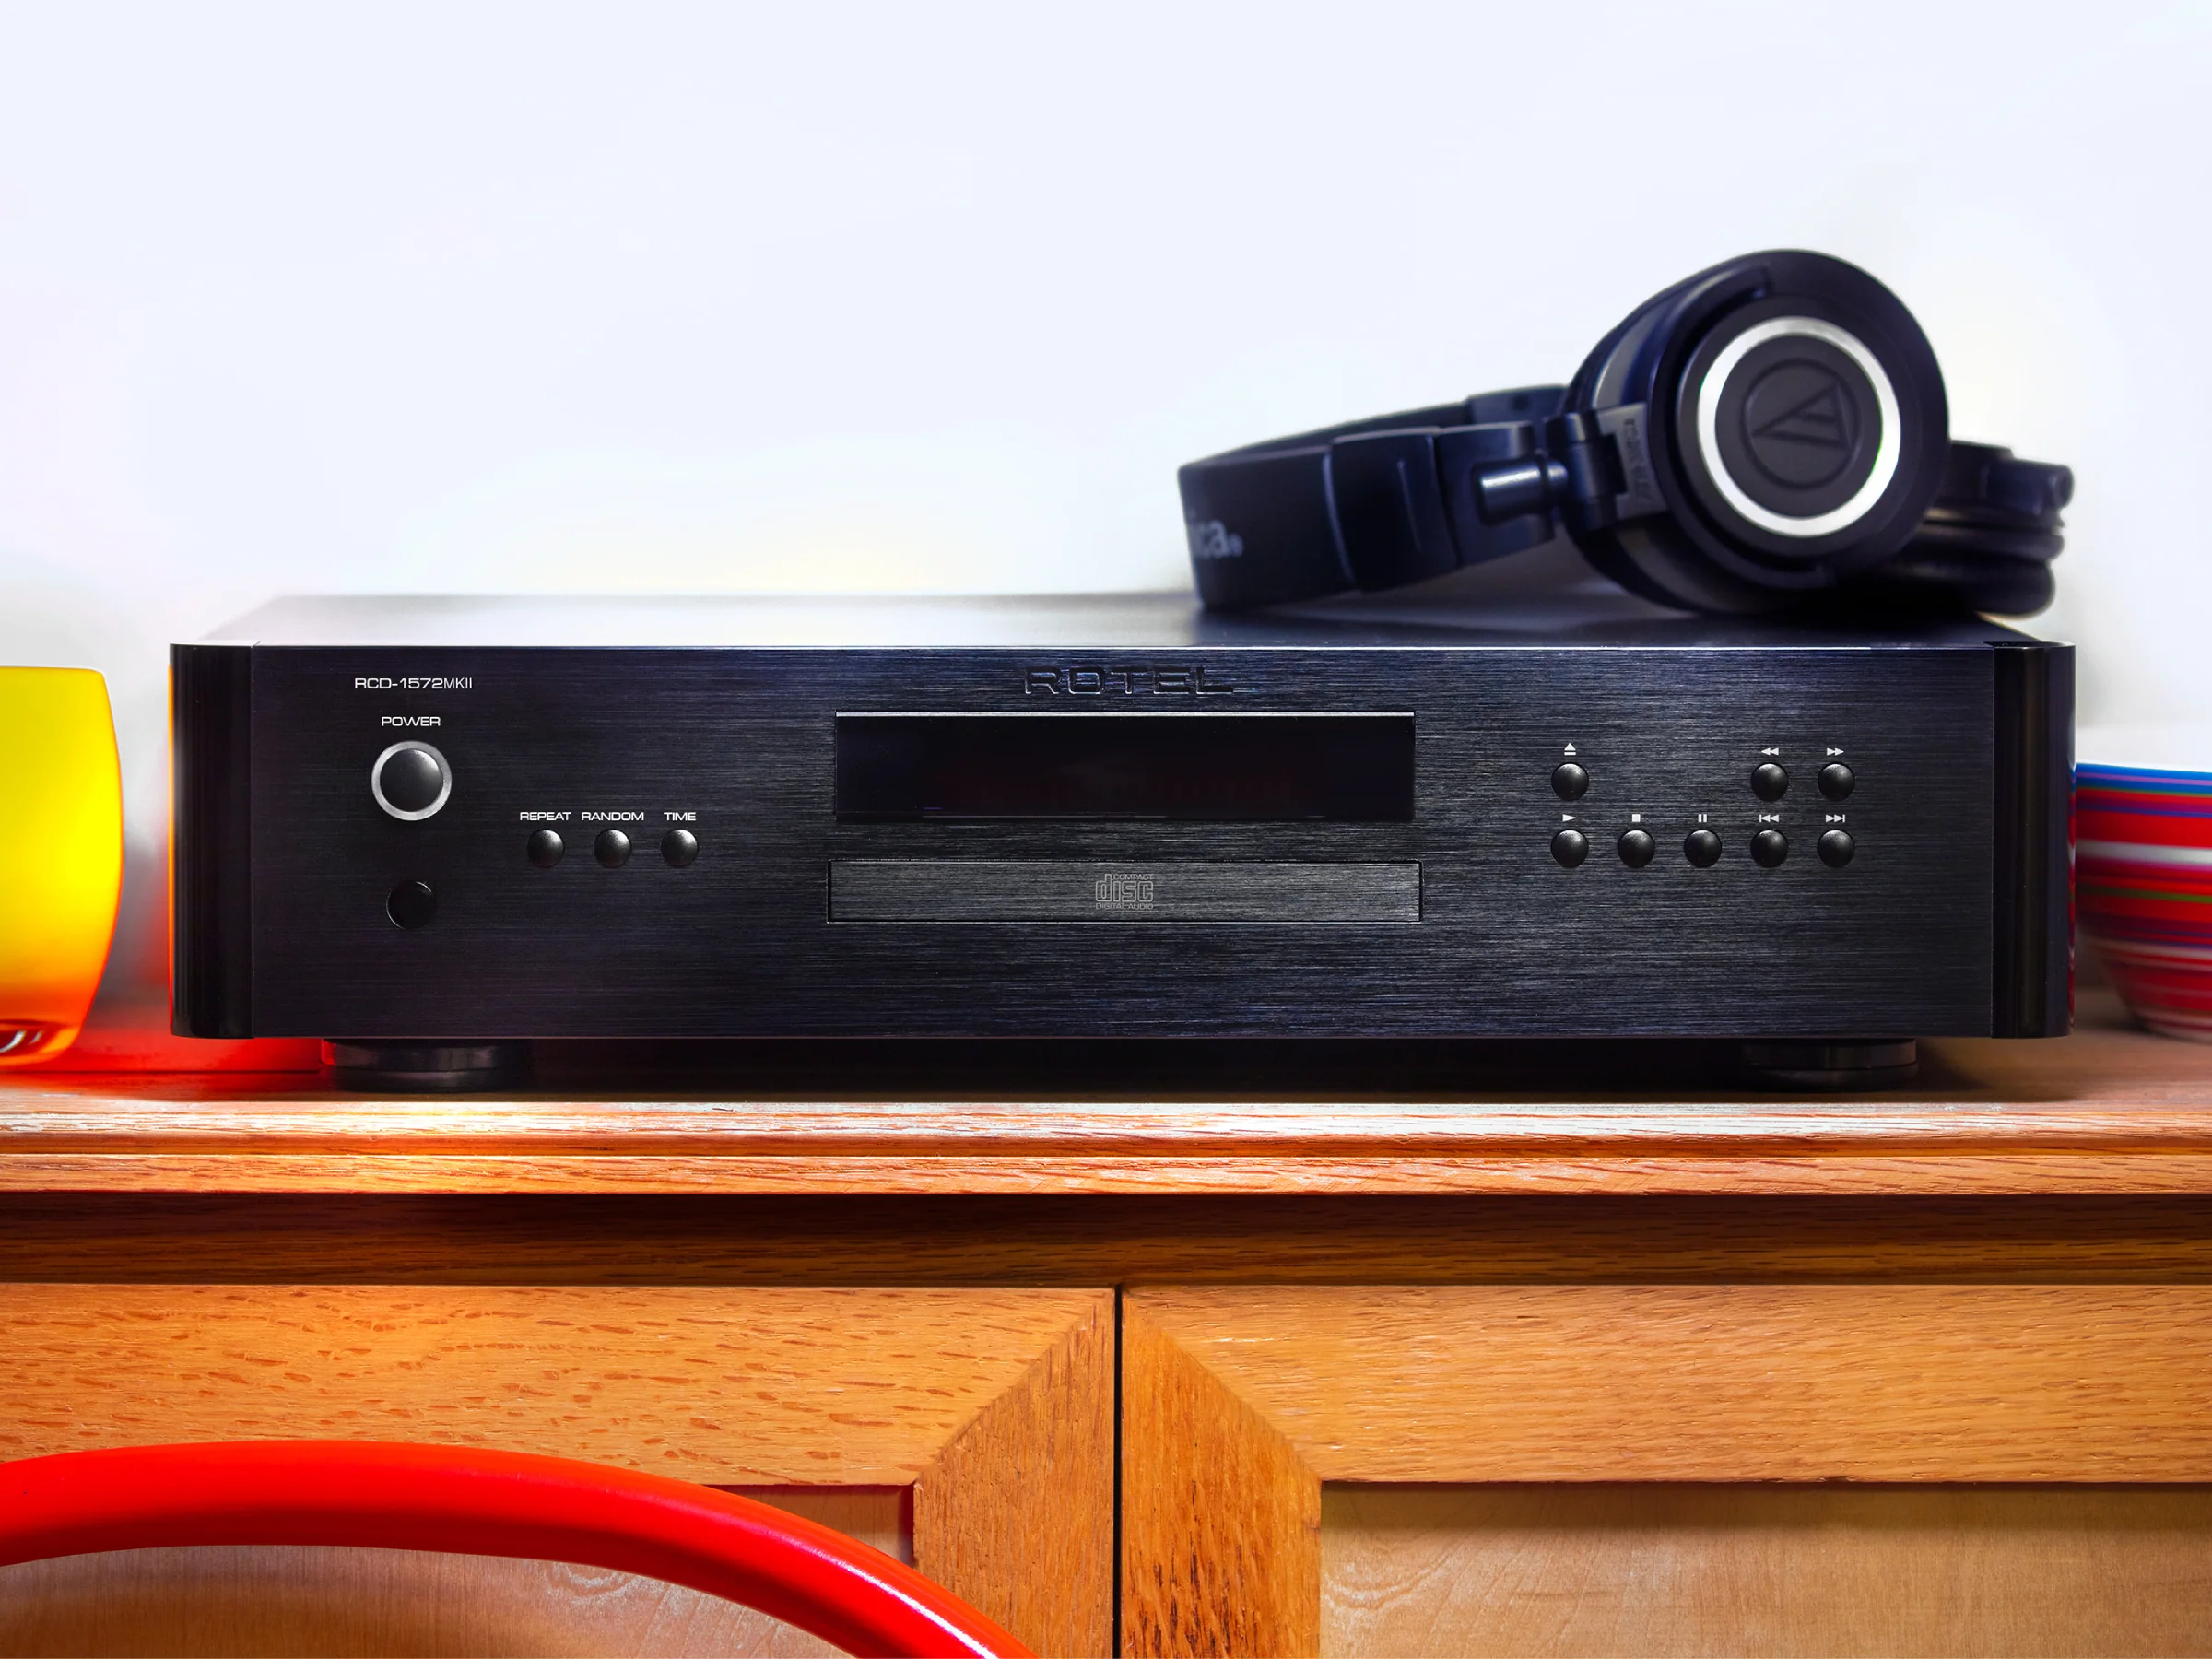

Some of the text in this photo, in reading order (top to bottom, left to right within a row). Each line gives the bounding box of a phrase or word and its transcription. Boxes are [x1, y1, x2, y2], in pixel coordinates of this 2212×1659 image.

[354, 677, 473, 689] RCD-1572MKII
[1025, 667, 1233, 694] ROTEL
[381, 716, 441, 726] POWER
[519, 812, 571, 821] REPEAT
[581, 812, 644, 821] RANDOM
[664, 812, 697, 821] TIME
